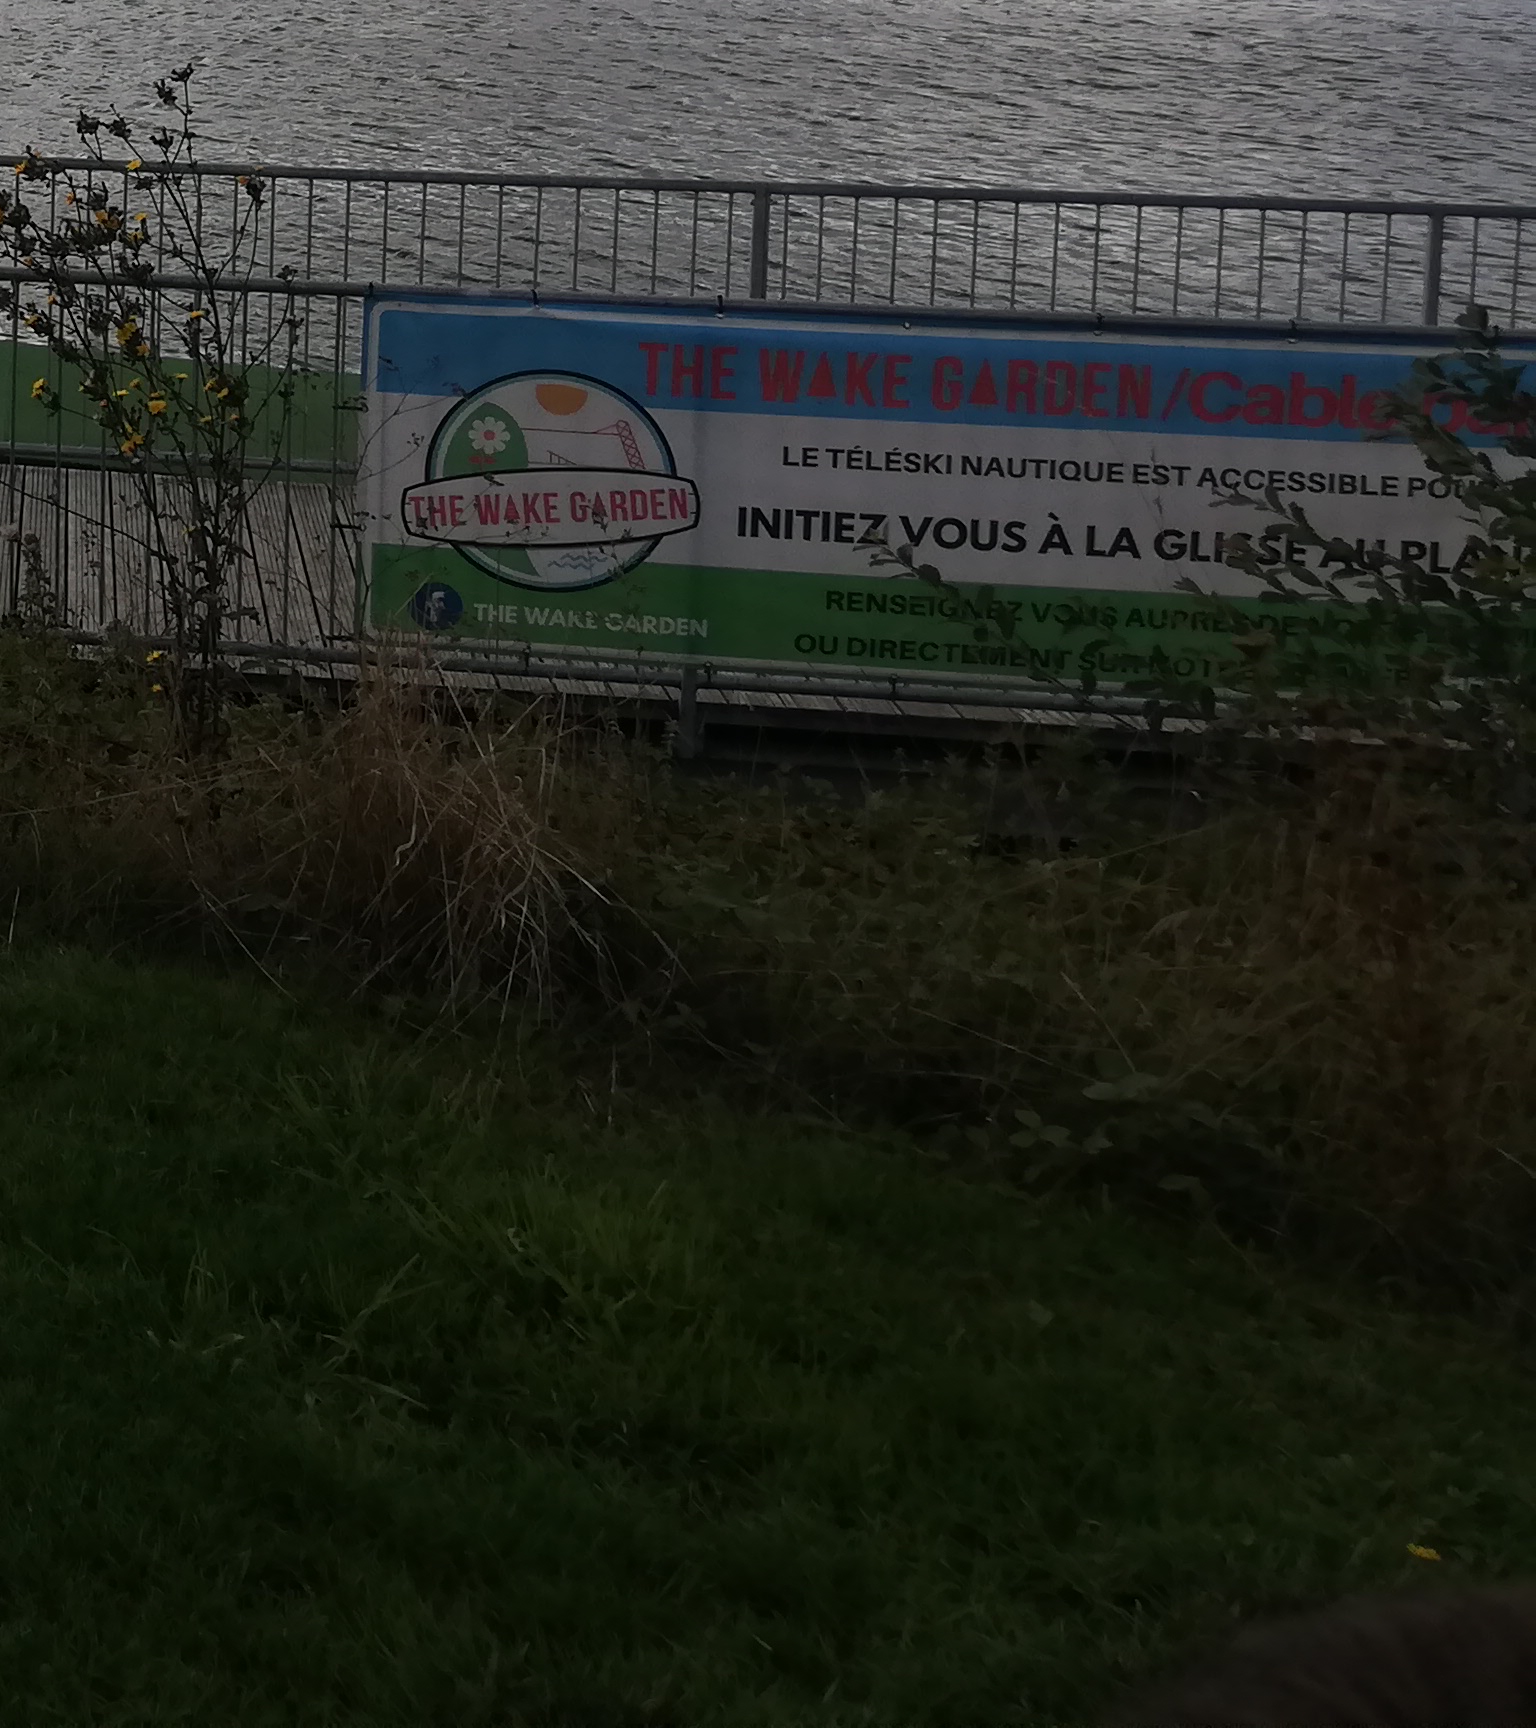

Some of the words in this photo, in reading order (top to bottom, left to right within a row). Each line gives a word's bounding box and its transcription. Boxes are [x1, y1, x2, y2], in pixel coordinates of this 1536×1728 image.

[638, 342, 739, 401] THE
[759, 347, 914, 408] WAKE
[931, 355, 1152, 420] GARDEN
[783, 446, 819, 467] LE
[825, 445, 952, 475] TÉLÉSKI
[961, 455, 1124, 484] NAUTIQUE
[1132, 463, 1191, 487] EST
[1197, 467, 1399, 498] ACCESSIBLE
[409, 496, 464, 527] THE
[475, 493, 561, 526] WAKE
[570, 488, 689, 524] GARDEN
[737, 506, 889, 544] INITIEZ
[899, 515, 1027, 553] VOUS
[1038, 512, 1073, 556] À
[1086, 525, 1141, 560] LA
[473, 602, 518, 624] THE
[524, 605, 599, 630] WAKE
[604, 612, 709, 638] GARDEN
[794, 633, 838, 656] OU
